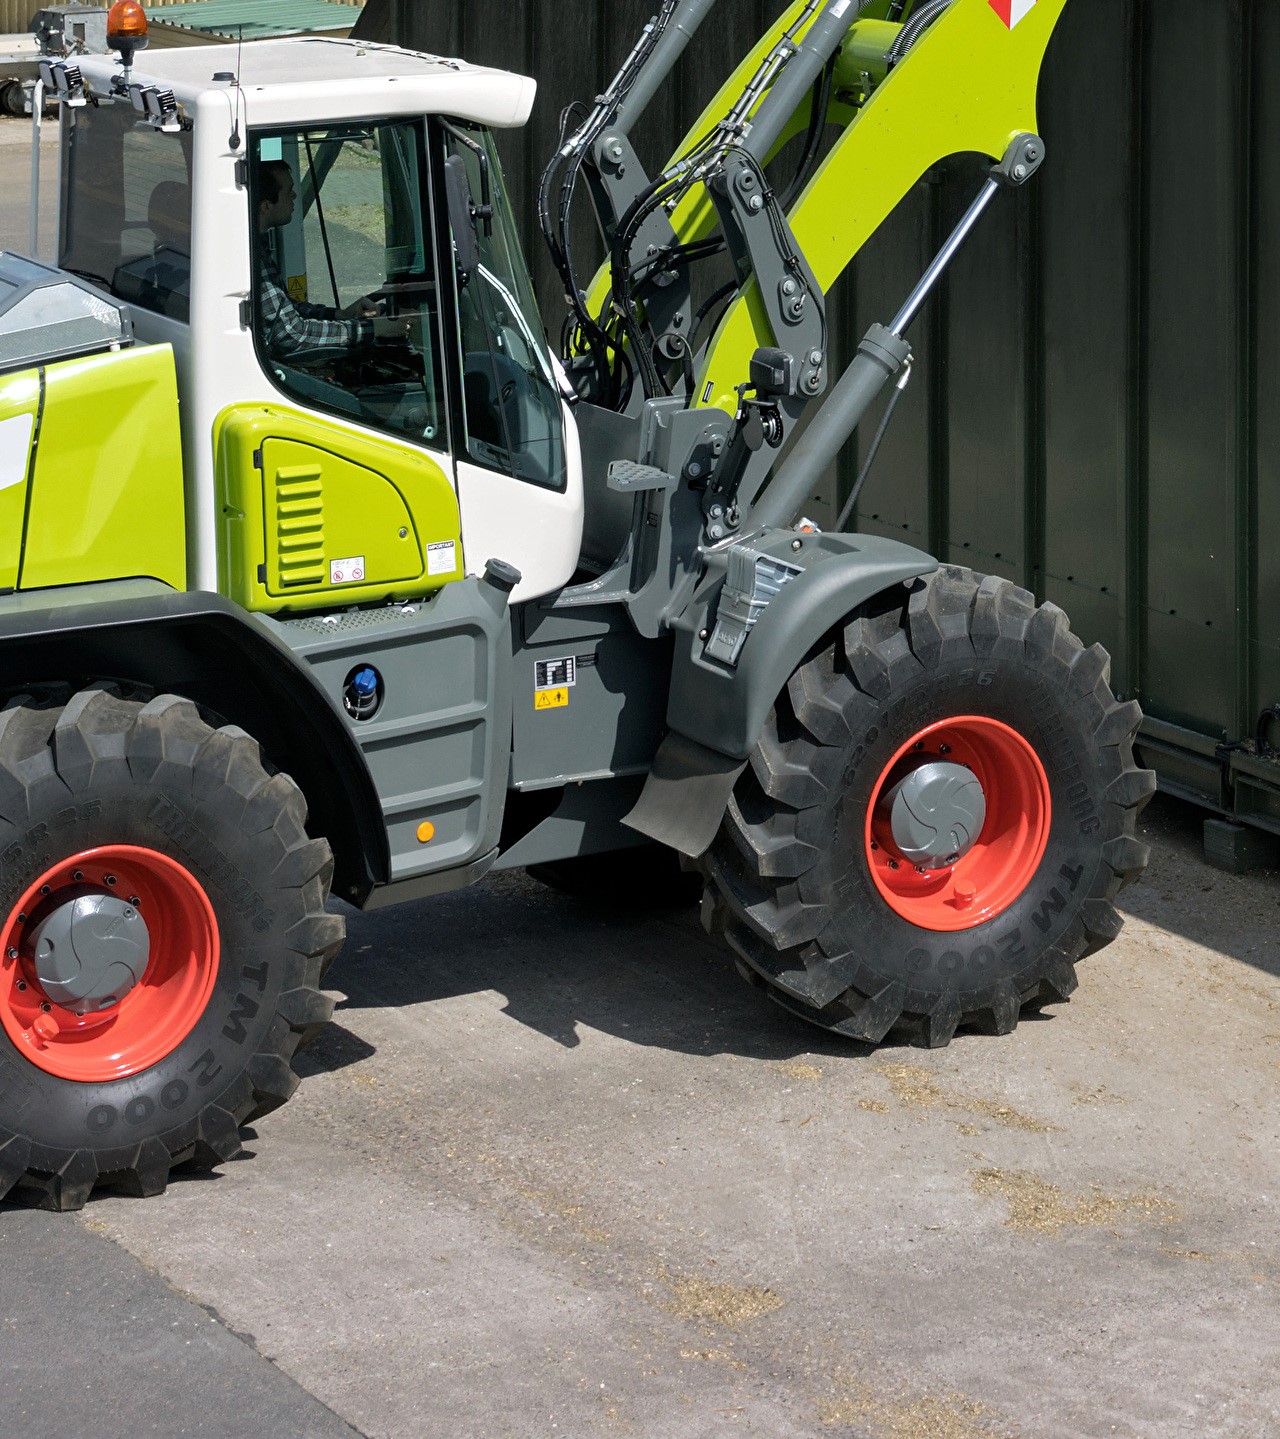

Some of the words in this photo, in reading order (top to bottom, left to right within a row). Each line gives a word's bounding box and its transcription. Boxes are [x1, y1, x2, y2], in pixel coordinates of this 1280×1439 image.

[1031, 863, 1084, 934] TM
[904, 927, 1026, 977] 2000
[222, 960, 270, 1046] TM
[85, 1047, 223, 1134] 2000
